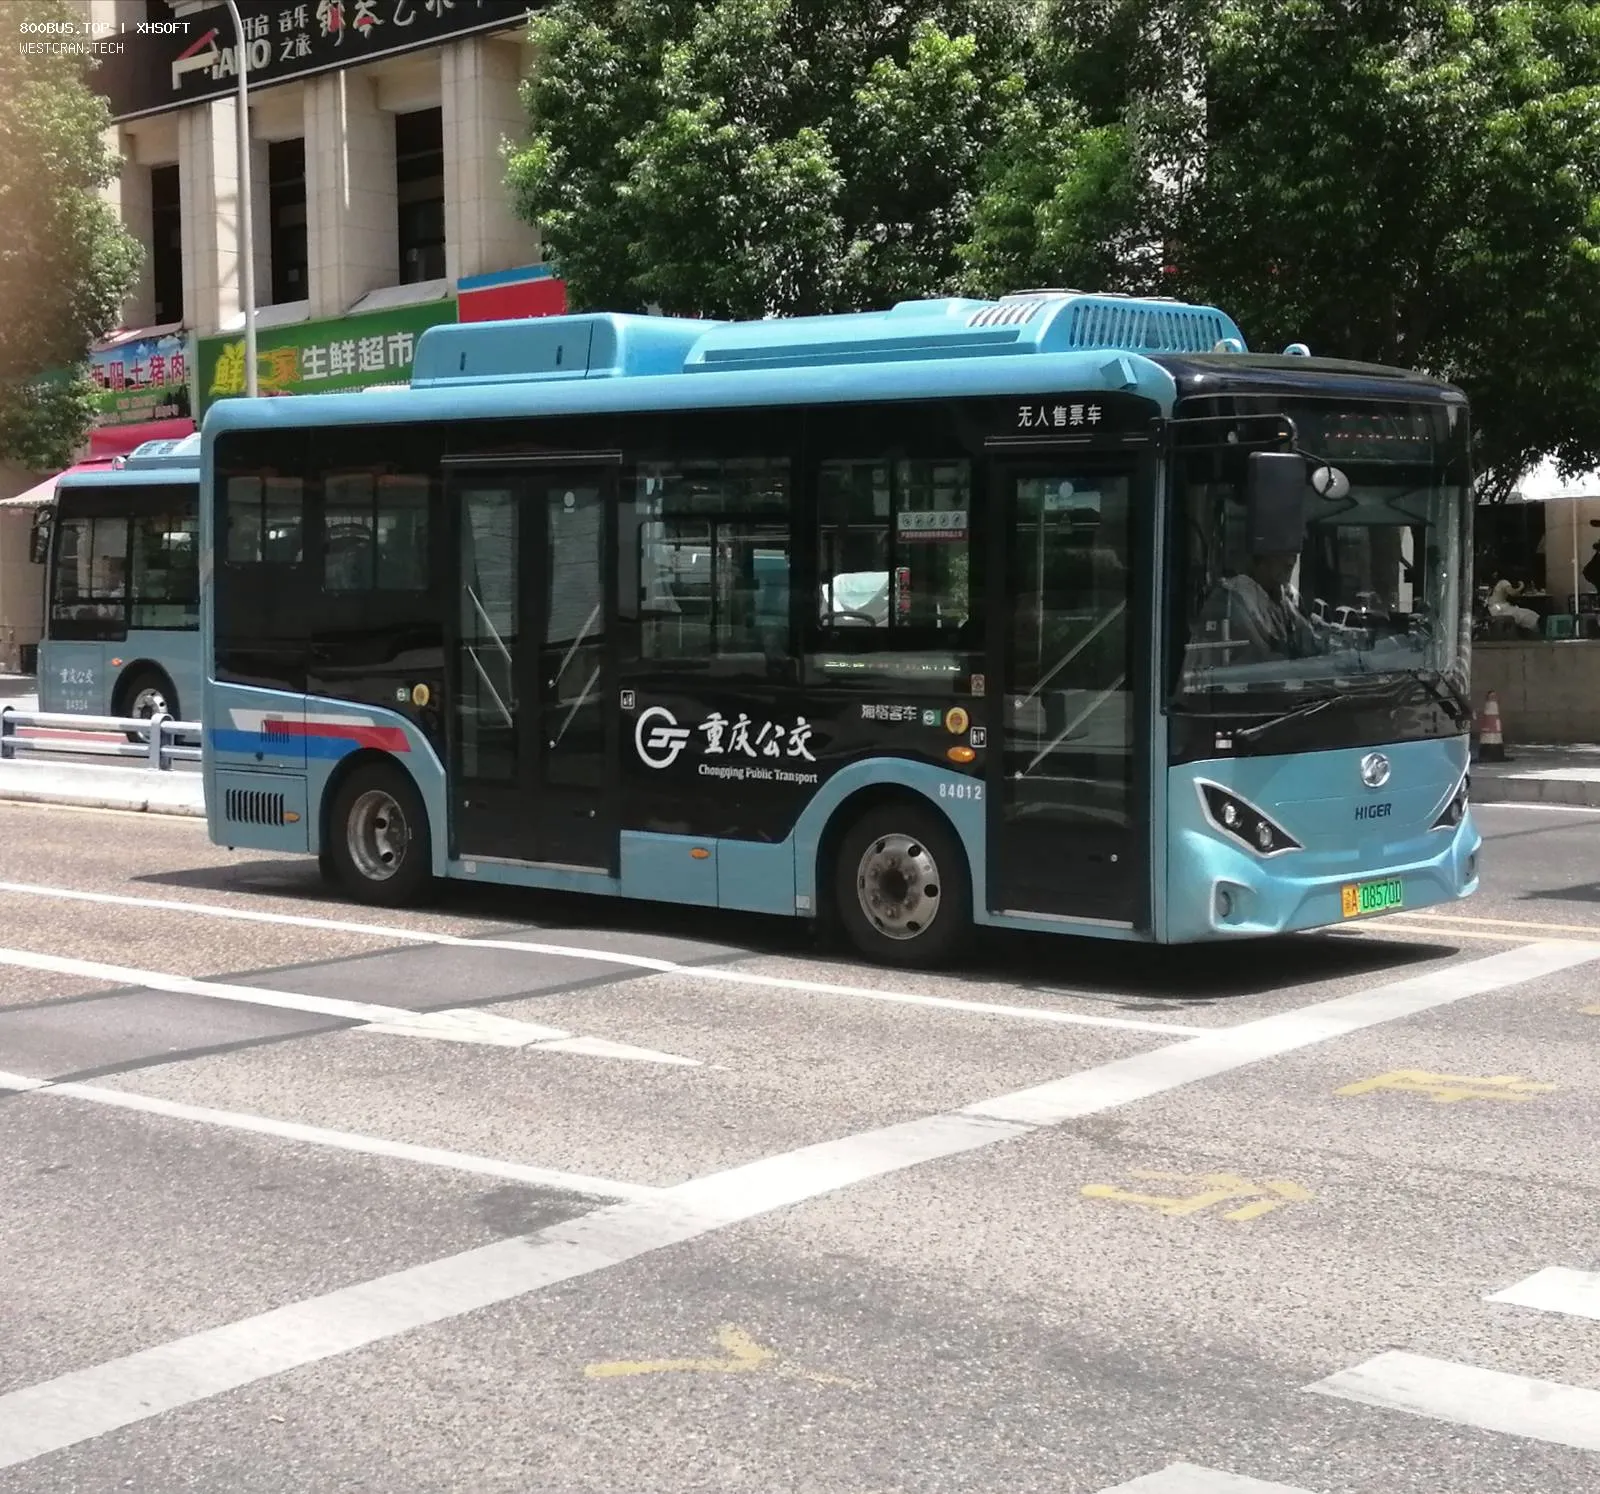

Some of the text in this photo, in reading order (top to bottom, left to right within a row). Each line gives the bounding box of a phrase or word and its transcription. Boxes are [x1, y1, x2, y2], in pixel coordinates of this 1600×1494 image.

[278, 4, 309, 33] 音乐
[279, 33, 312, 61] 之旅
[302, 332, 414, 381] 生鲜超市
[1017, 403, 1102, 428] 无人售票车
[698, 712, 817, 762] 重庆公交
[698, 763, 818, 784] Chongqing Public Transport
[939, 783, 982, 800] 84012
[1355, 803, 1392, 821] HIGER
